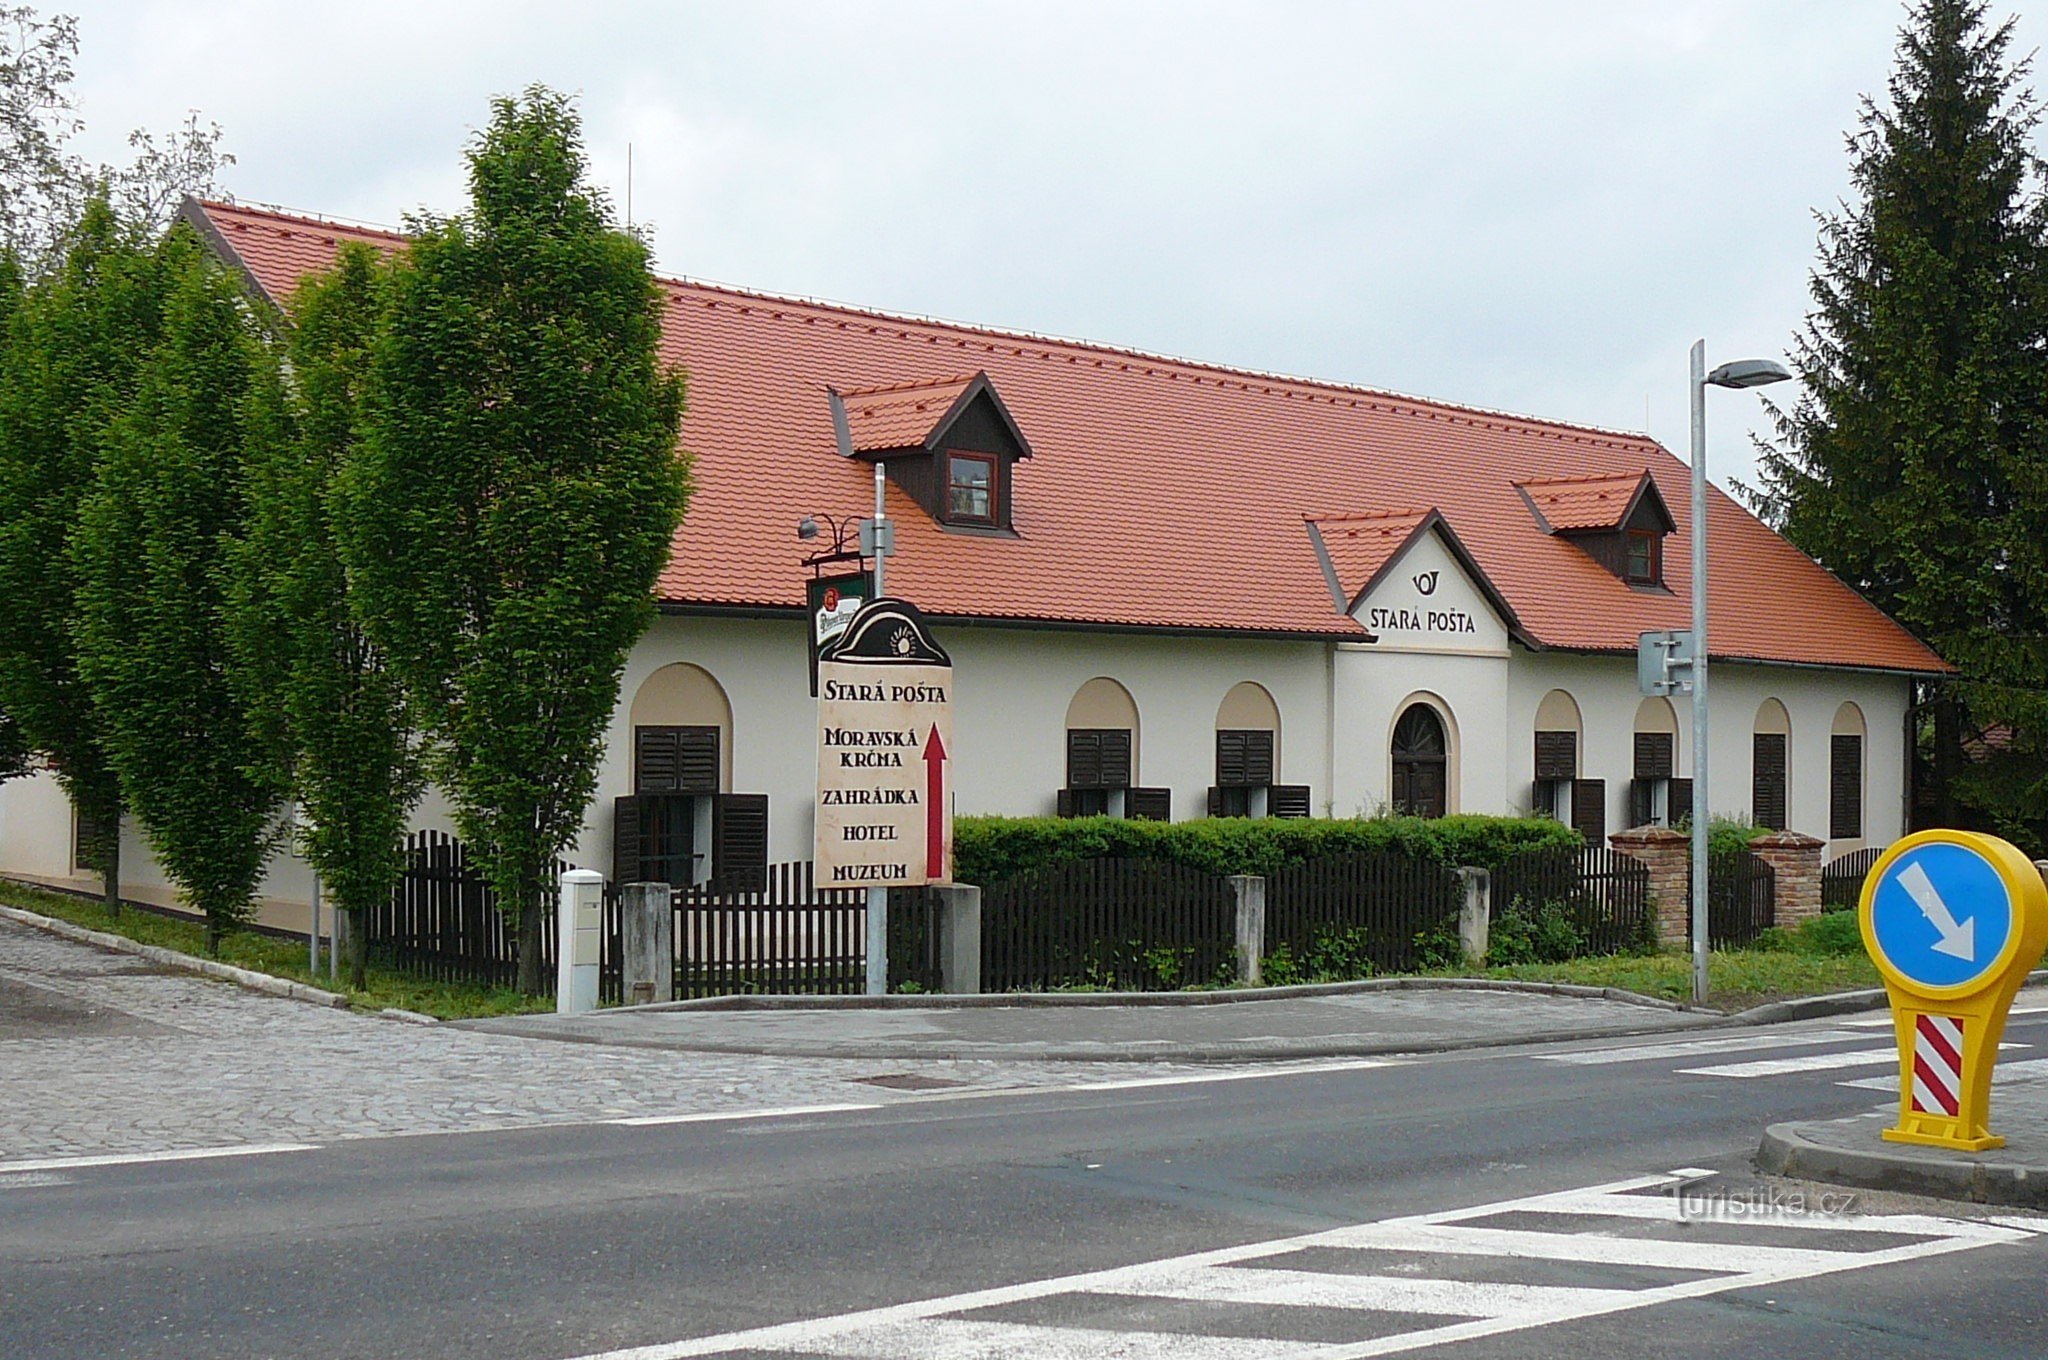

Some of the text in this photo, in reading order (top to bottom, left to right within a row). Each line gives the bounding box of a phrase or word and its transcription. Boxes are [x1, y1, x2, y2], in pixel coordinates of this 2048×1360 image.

[1371, 605, 1476, 633] STARÁ POŠTA
[824, 679, 947, 703] STARÁ POŠTA
[824, 727, 918, 747] MORAVSKÁ
[840, 749, 903, 768] KRČMA
[822, 786, 919, 805] ZAHRÁDKA
[843, 825, 898, 841] HOTEL
[832, 864, 907, 881] MUZEUM
